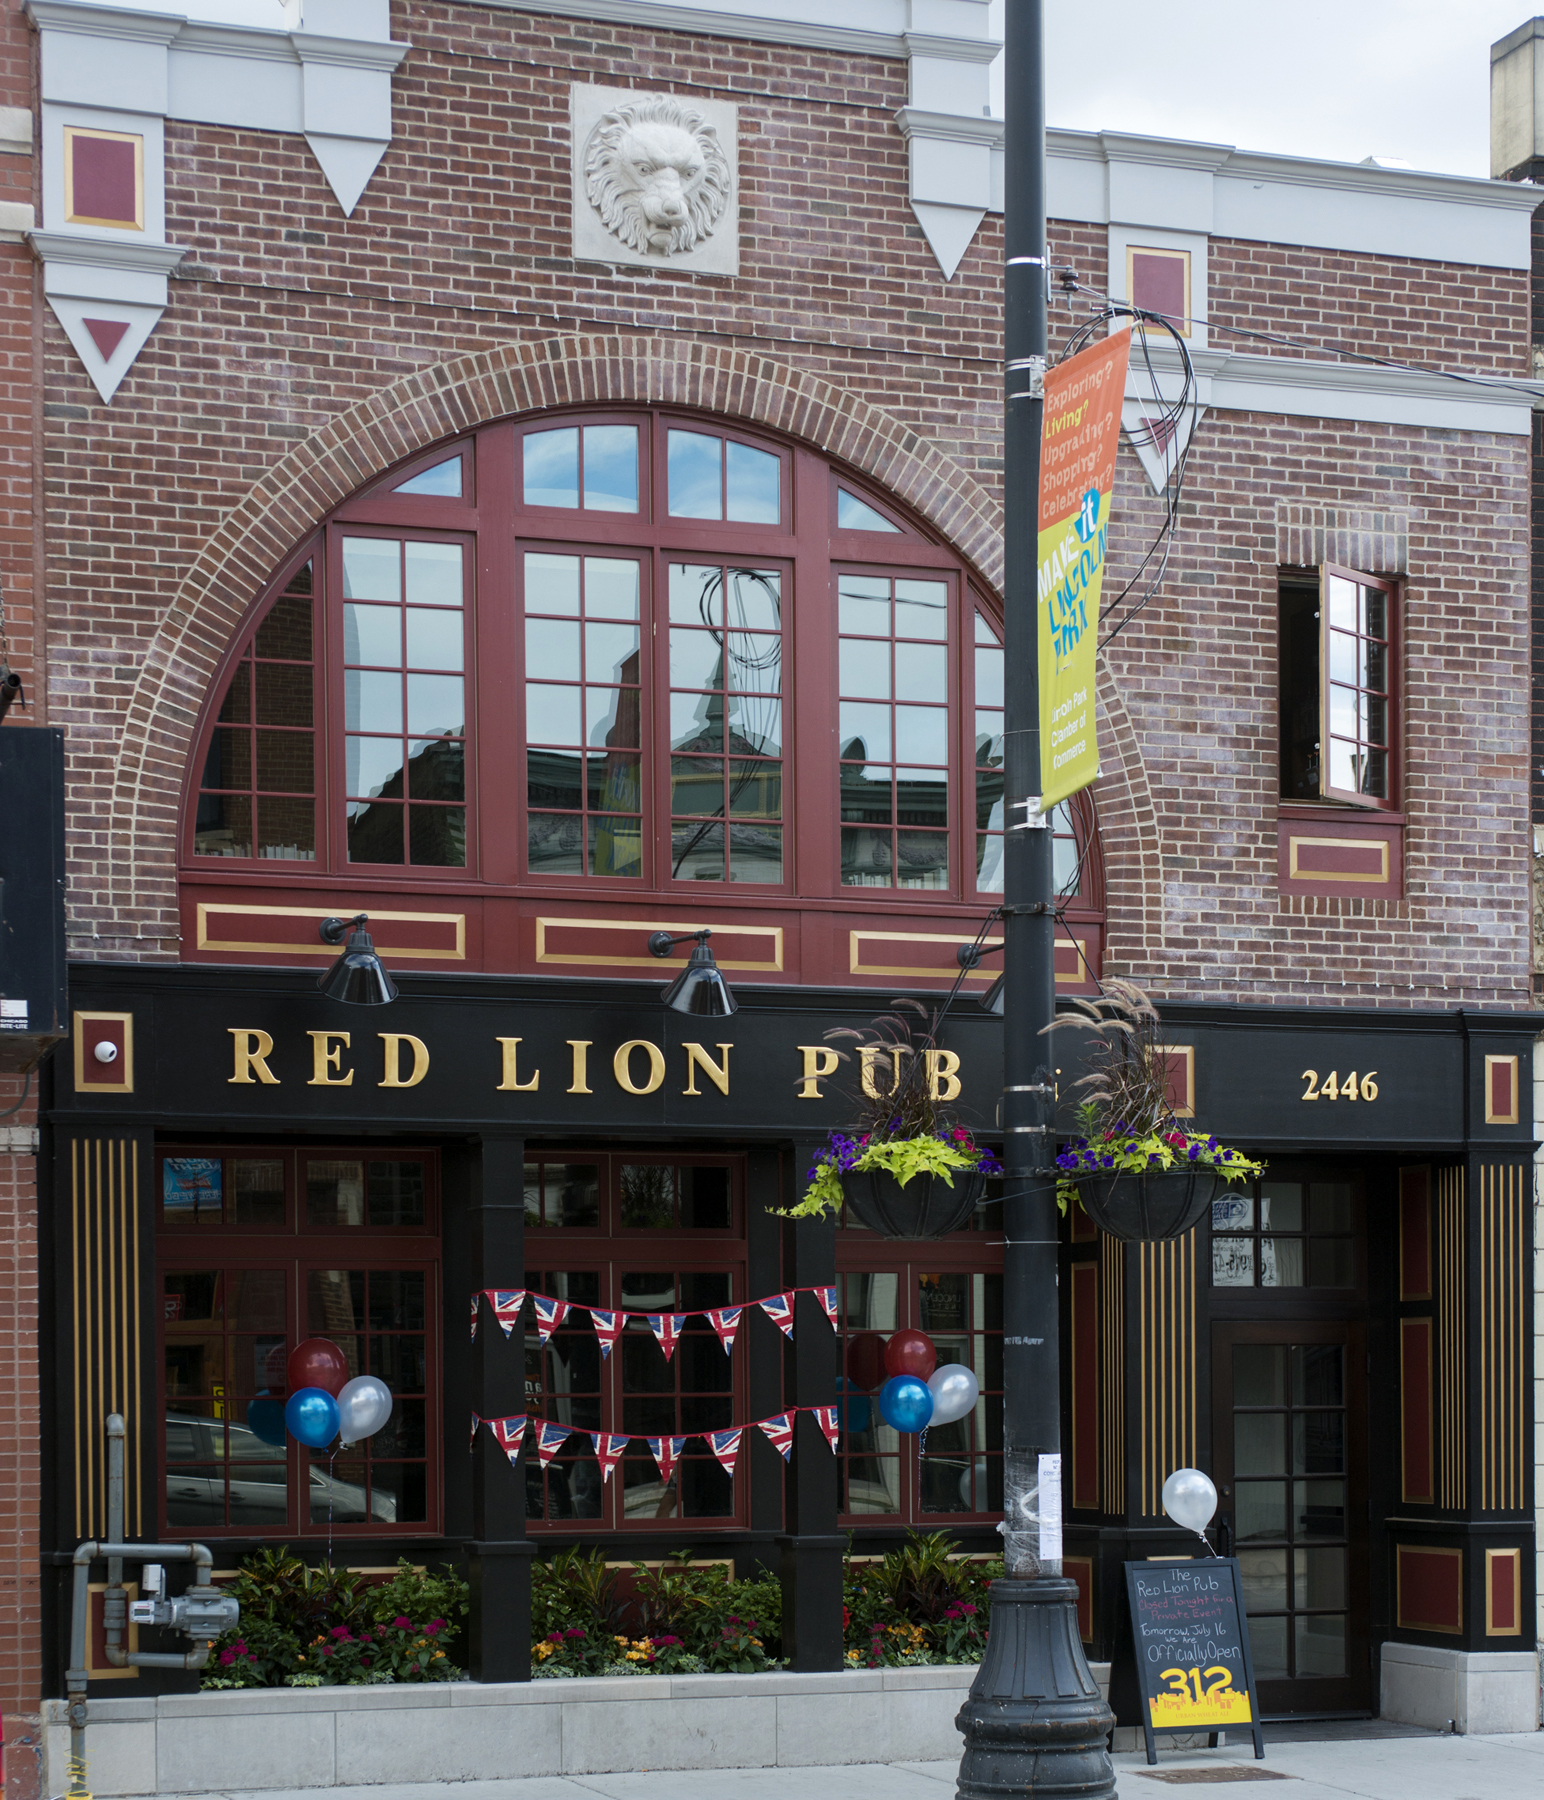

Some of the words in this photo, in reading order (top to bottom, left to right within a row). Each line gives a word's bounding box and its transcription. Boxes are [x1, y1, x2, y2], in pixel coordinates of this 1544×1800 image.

[1046, 360, 1113, 413] Exploring?
[1045, 399, 1089, 440] Living?
[1044, 411, 1113, 466] Upgrading?
[1081, 494, 1097, 541] it
[1073, 686, 1088, 709] Park
[1079, 709, 1087, 729] of
[227, 1027, 431, 1089] RED
[494, 1036, 735, 1097] LION
[796, 1045, 962, 1102] PUB
[1300, 1069, 1379, 1102] 2446
[1169, 1569, 1192, 1581] The
[1193, 1575, 1219, 1591] Pub
[1138, 1597, 1169, 1611] Closed
[1171, 1594, 1210, 1608] Tonight
[1226, 1596, 1234, 1604] a
[1151, 1609, 1190, 1621] Private
[1192, 1607, 1222, 1618] Event
[1190, 1623, 1211, 1637] July
[1214, 1622, 1227, 1636] 16
[1147, 1643, 1208, 1668] Officially
[1206, 1640, 1241, 1662] Open
[1159, 1665, 1234, 1704] 312
